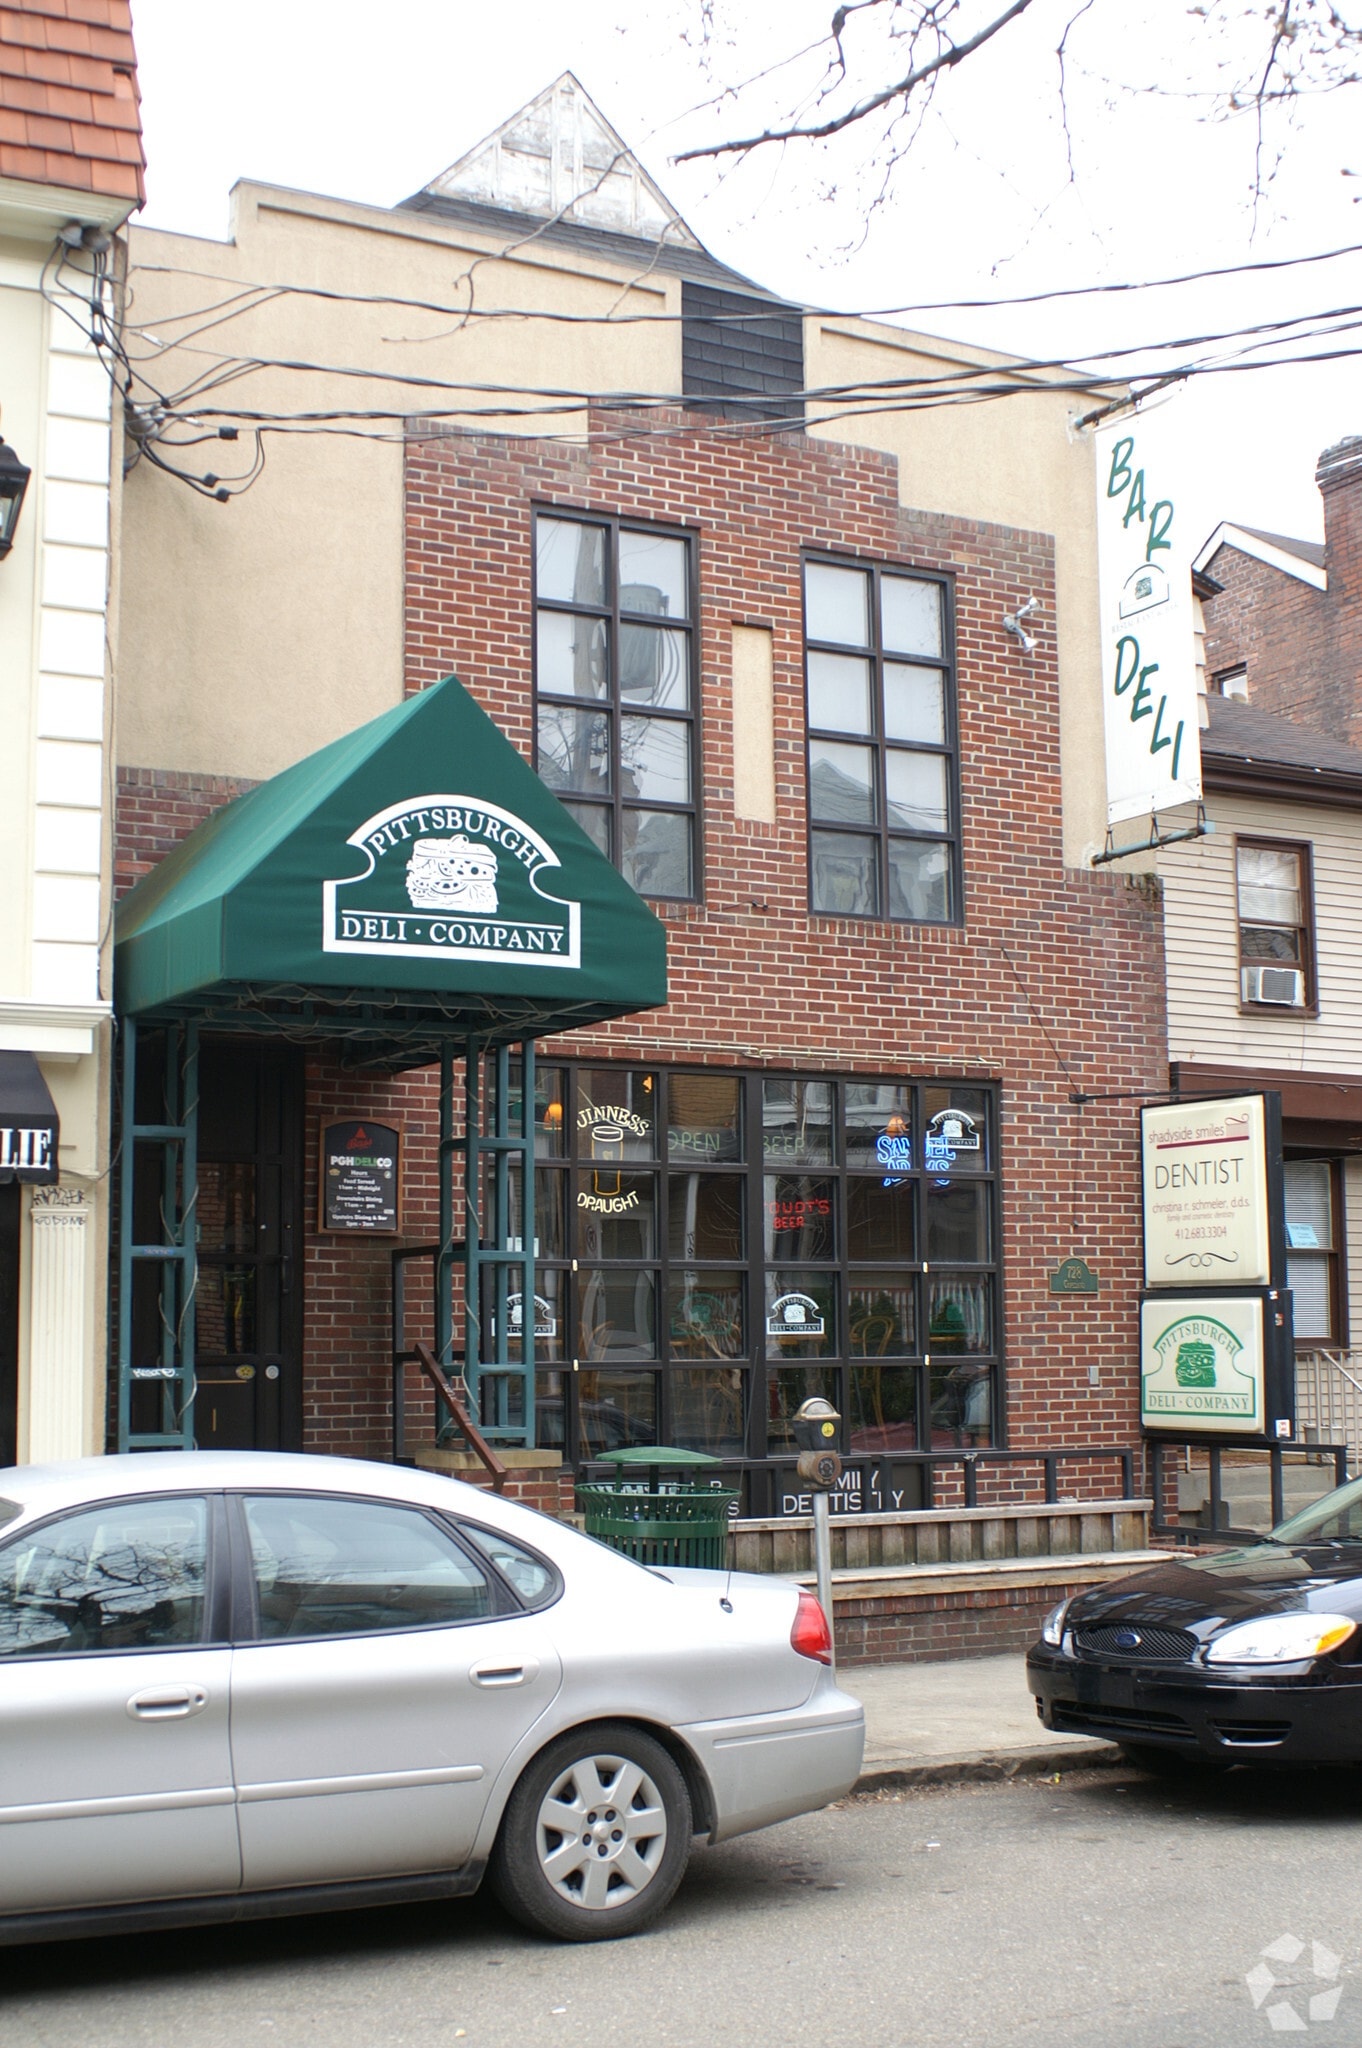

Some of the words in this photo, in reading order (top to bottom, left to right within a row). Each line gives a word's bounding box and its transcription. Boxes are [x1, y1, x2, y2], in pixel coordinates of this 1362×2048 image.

[1107, 436, 1174, 562] BAR
[1115, 635, 1185, 780] DELI
[367, 808, 540, 869] PITTSBURGH
[341, 917, 407, 942] DELI
[429, 923, 564, 952] COMPANY
[577, 1106, 649, 1137] UINNESS
[1149, 1127, 1193, 1144] shadyside
[1196, 1124, 1225, 1139] smiles
[1155, 1158, 1243, 1190] DENTIST
[577, 1191, 639, 1213] DRAUGHT
[774, 1216, 804, 1229] BEER
[1159, 1322, 1236, 1355] PITTSBURGH
[1149, 1394, 1176, 1408] DELI
[1186, 1396, 1249, 1410] COMPANY
